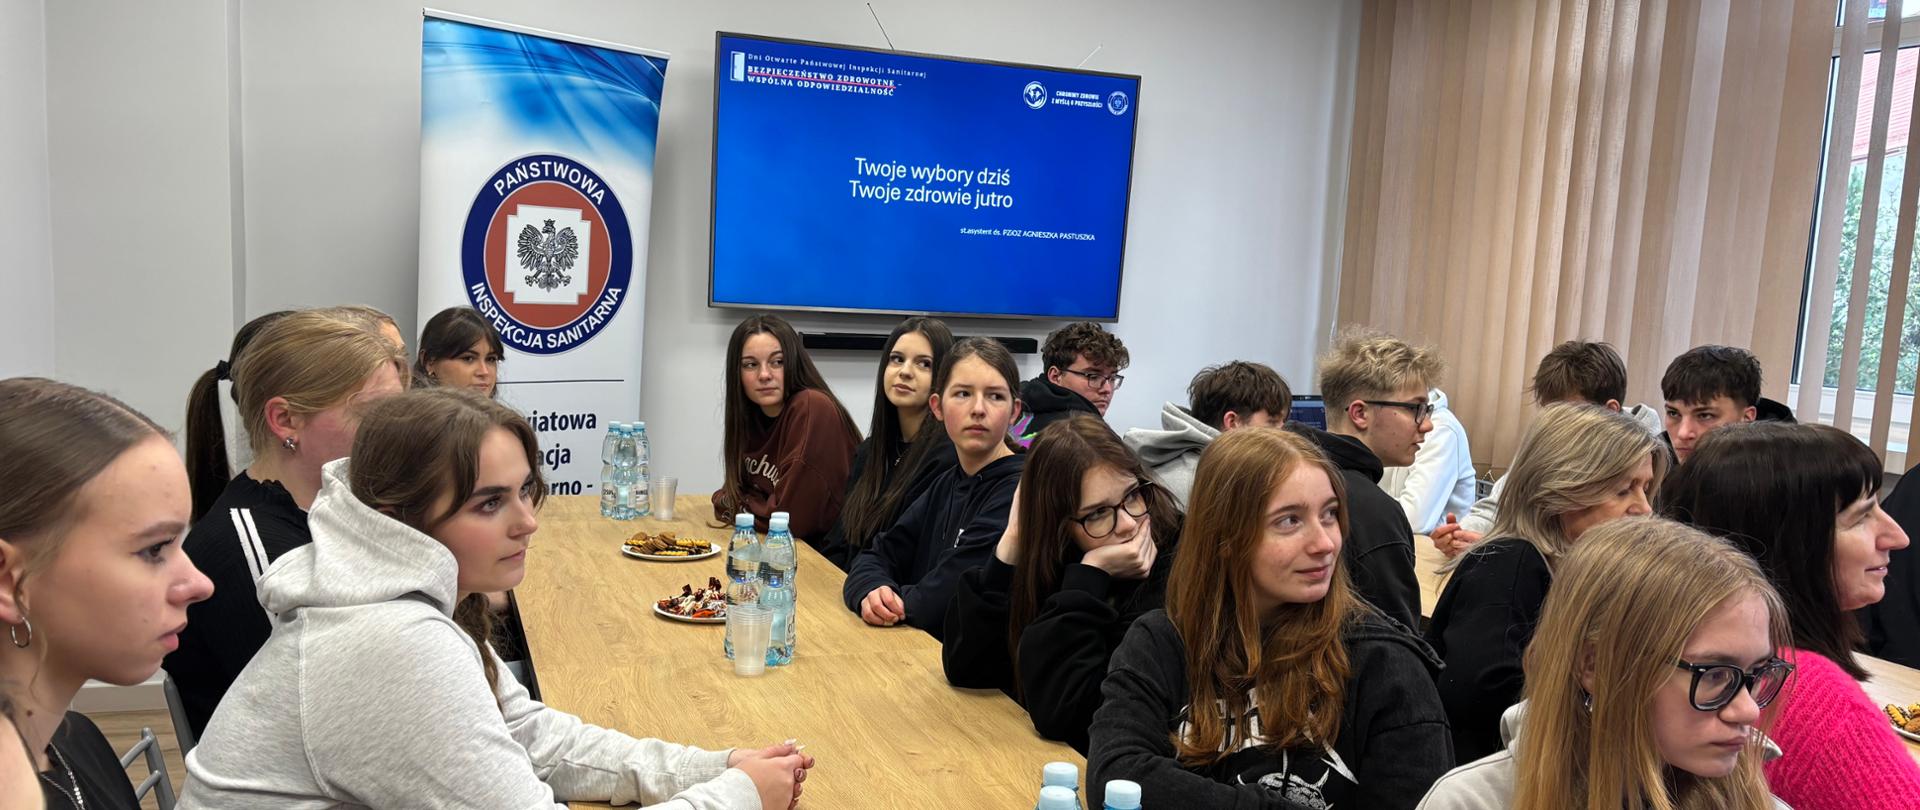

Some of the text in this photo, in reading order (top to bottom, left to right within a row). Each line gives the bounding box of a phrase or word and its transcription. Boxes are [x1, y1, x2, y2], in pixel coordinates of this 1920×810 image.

[747, 65, 834, 81] BEZPIECZEŃSTWO
[837, 74, 895, 87] ZDROWOTNE
[748, 53, 927, 79] Dni Otwarte Państwowej Inspekcji Sanitarnej
[747, 75, 895, 97] WSPÓLNA ODPOWIEDZIALNOŚĆ
[494, 161, 606, 205] PAŃSTWOWA
[854, 157, 1011, 187] Twoje wybory dziś
[849, 180, 1013, 209] Twoje zdrowie jutro
[1022, 231, 1058, 239] AGNIESZKA
[1059, 232, 1096, 241] PASTUSZKA
[471, 282, 622, 349] INSPEKCJA SANITARNA
